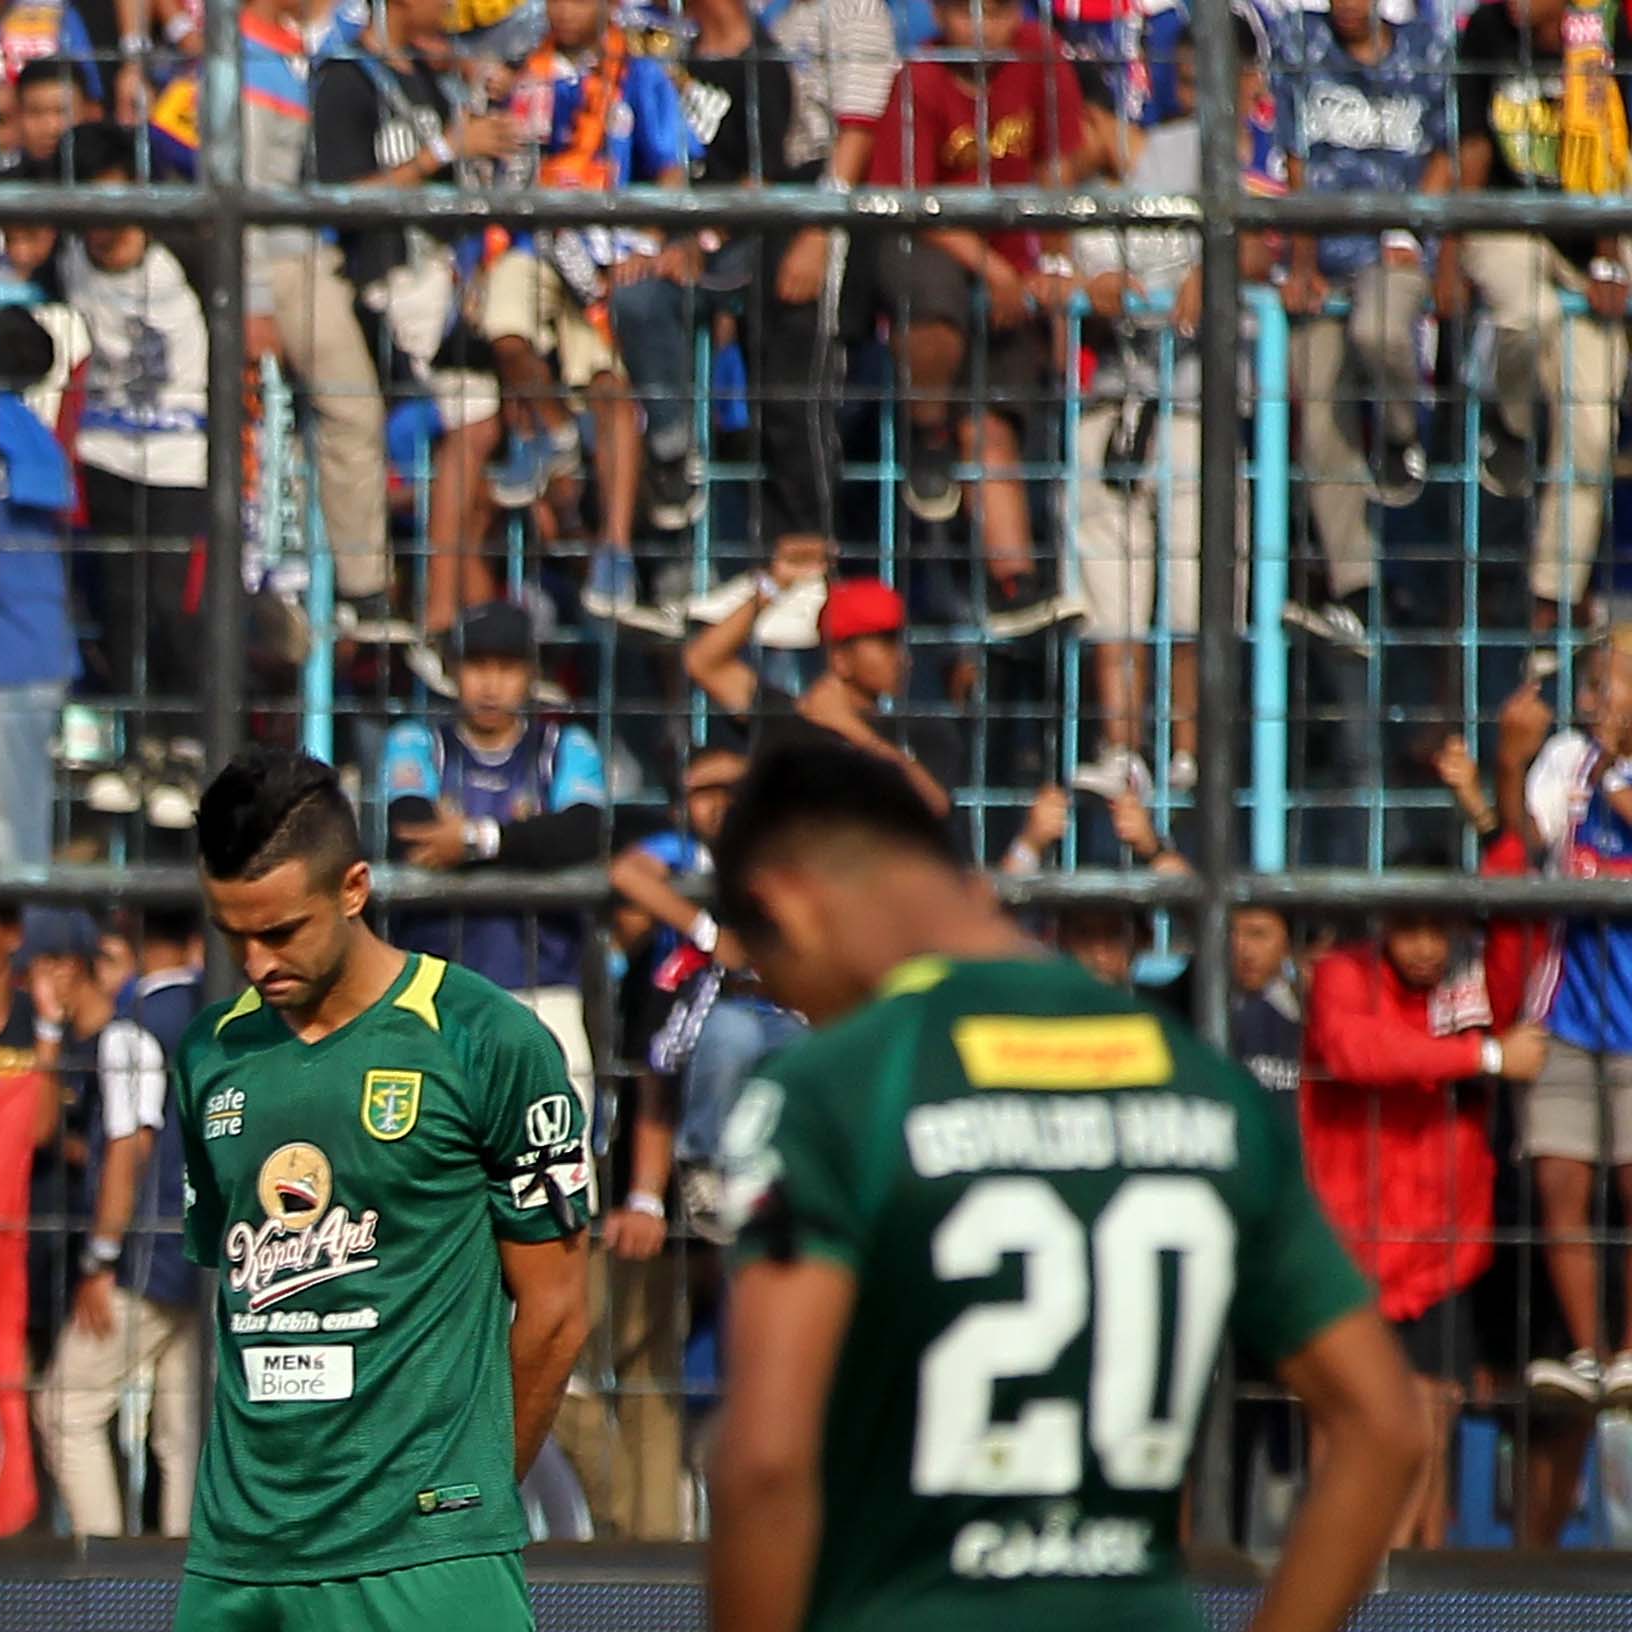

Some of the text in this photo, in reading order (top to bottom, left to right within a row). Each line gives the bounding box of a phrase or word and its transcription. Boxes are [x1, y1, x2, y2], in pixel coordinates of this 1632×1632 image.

[207, 1088, 246, 1114] safe
[227, 1206, 378, 1292] Kapal Api
[910, 1172, 1237, 1497] 20
[261, 1372, 326, 1396] Bioré
